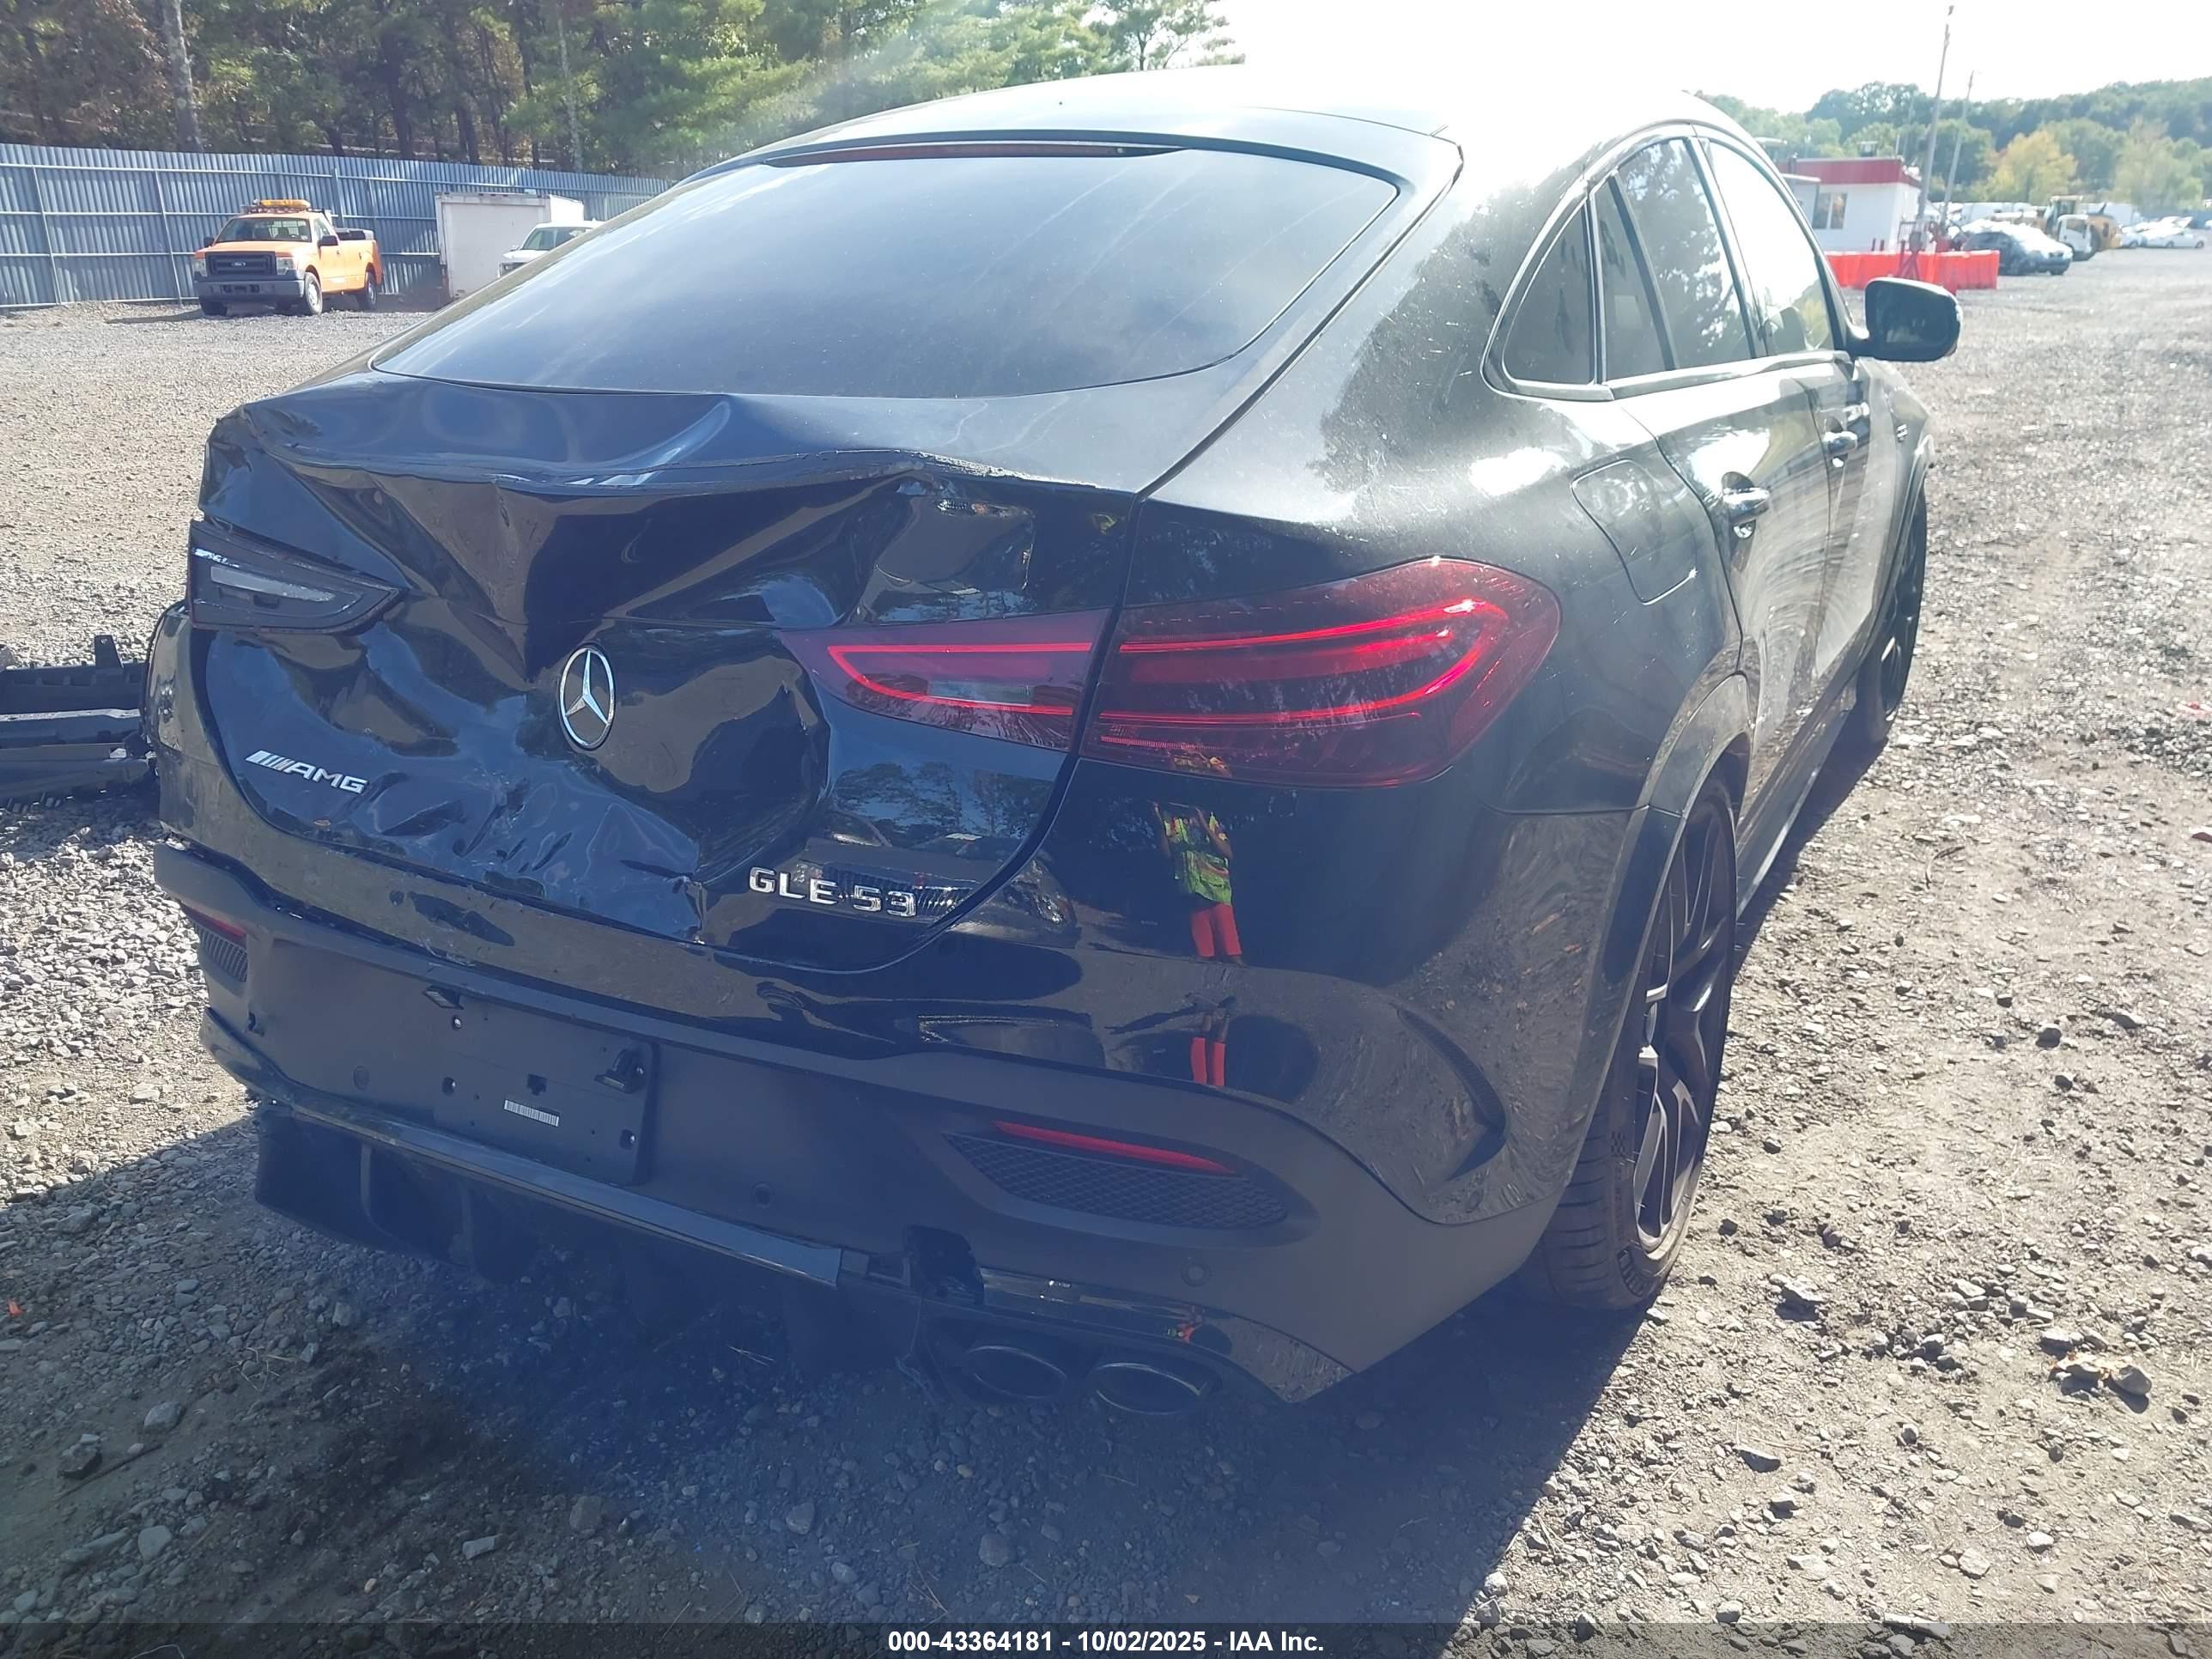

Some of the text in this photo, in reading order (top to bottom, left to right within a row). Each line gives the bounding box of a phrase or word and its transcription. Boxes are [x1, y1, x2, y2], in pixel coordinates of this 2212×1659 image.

[283, 762, 369, 794] AMG
[749, 866, 917, 917] GLE 53
